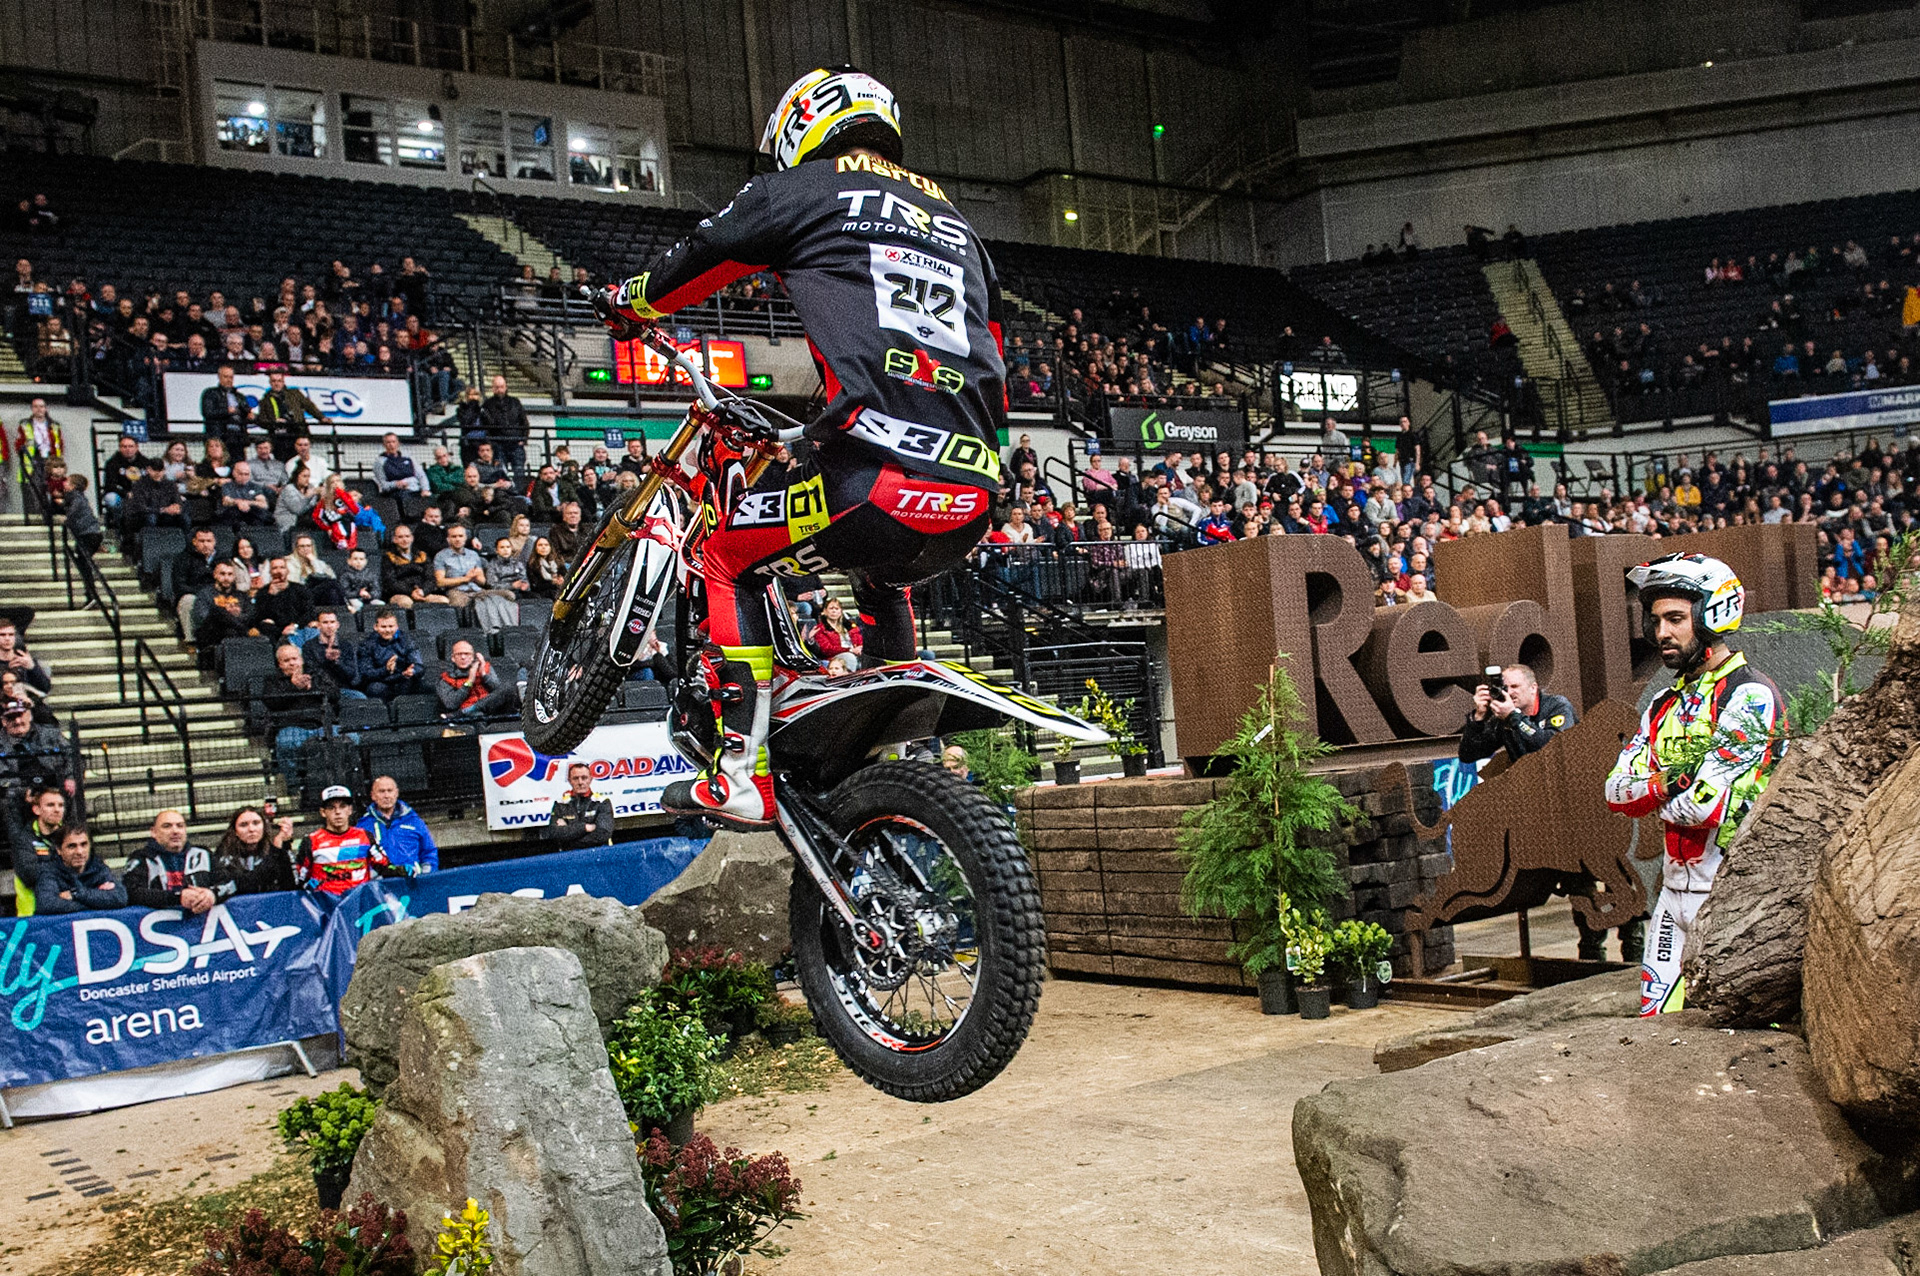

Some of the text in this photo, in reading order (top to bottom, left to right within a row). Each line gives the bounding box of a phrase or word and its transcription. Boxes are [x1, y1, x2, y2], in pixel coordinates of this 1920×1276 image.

[836, 154, 955, 207] Marty
[838, 190, 968, 246] TRS
[842, 221, 967, 256] MOTORCYCLES
[883, 272, 958, 332] 212
[1164, 421, 1218, 441] Grayson
[890, 510, 970, 520] MOTORCYCLES
[897, 489, 979, 513] TRS
[1706, 586, 1744, 624] TR
[1266, 524, 1584, 746] Red
[72, 904, 255, 986] DSA
[80, 966, 257, 1002] Doncaster Sheffield Airport
[86, 1004, 204, 1045] arena
